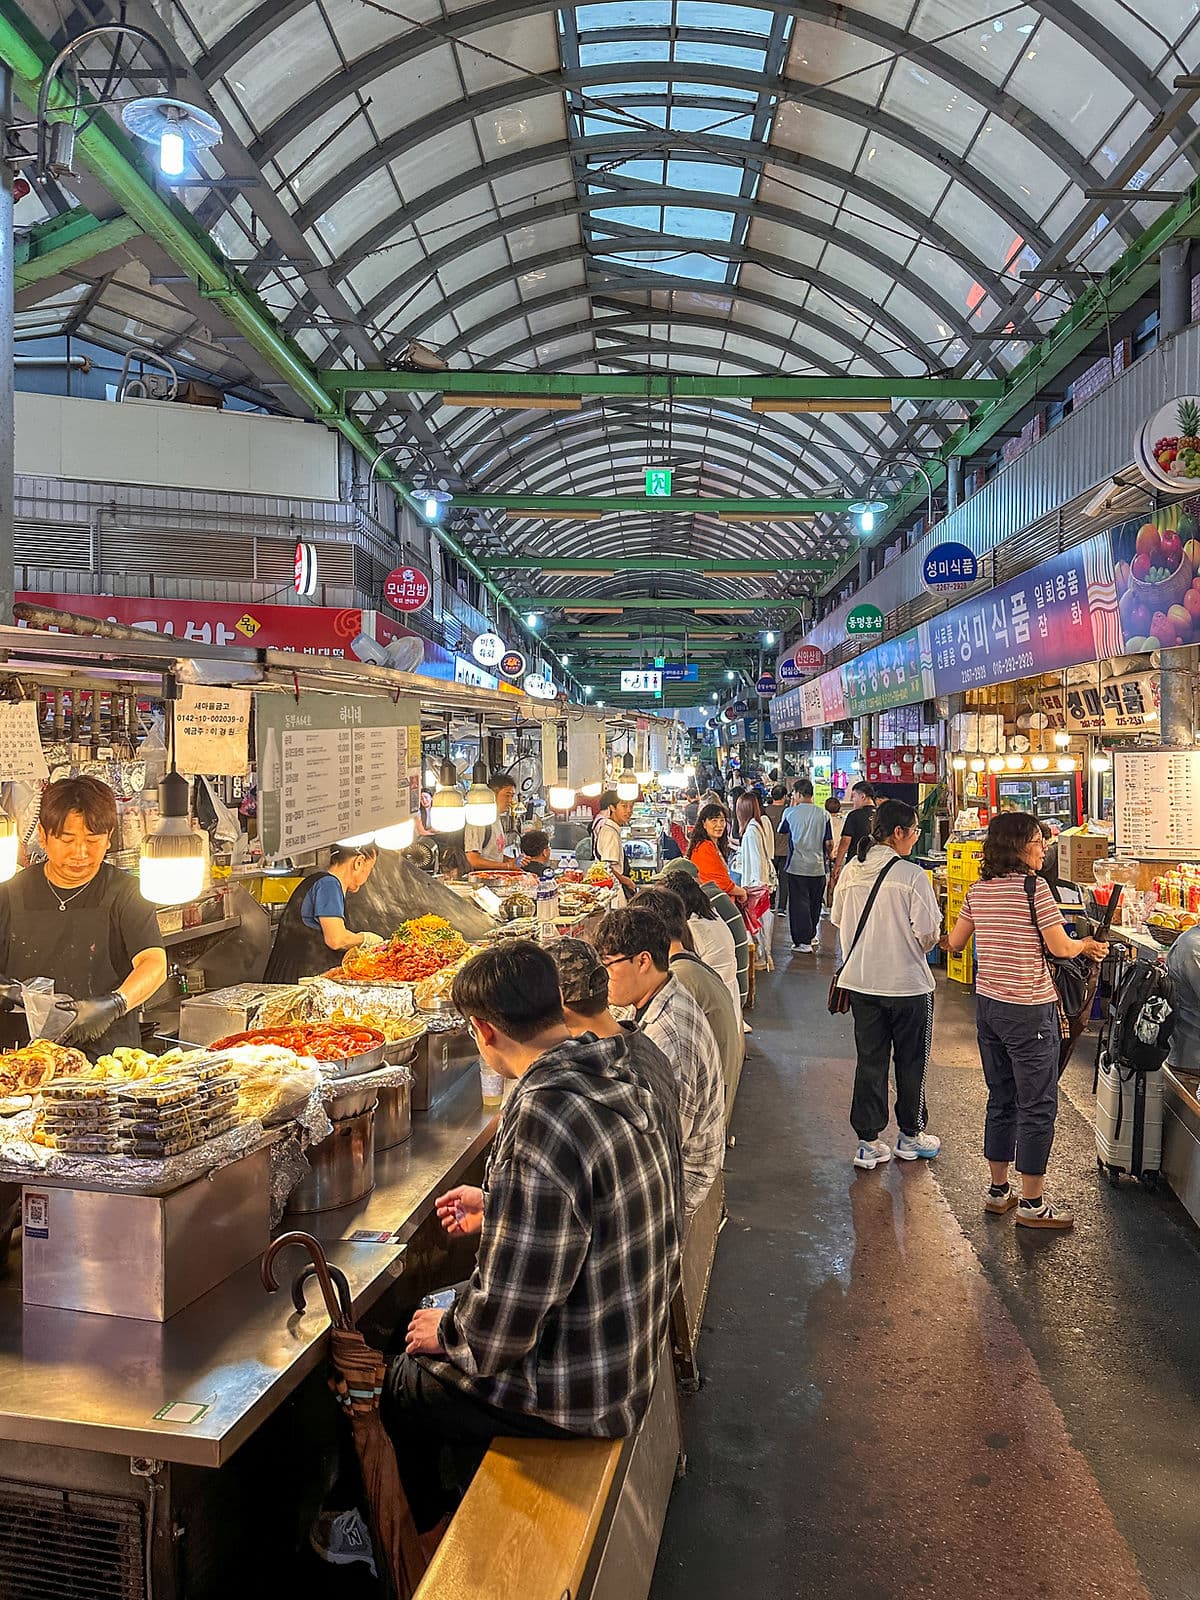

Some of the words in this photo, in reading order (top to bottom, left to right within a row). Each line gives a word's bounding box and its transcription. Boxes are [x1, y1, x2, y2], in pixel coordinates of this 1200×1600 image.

[926, 558, 974, 578] 성미식품
[387, 582, 427, 597] 모녀김밥
[1034, 569, 1079, 609] 일회용품
[240, 616, 257, 633] 모녀
[847, 615, 882, 629] 동명홍삼
[957, 590, 1031, 662] 성미식품
[1037, 613, 1048, 638] 잡
[1070, 600, 1083, 626] 화
[934, 624, 953, 647] 식료품
[937, 647, 956, 669] 선물용
[858, 642, 906, 696] 동명홍삼
[194, 702, 230, 710] 새마을금고
[1067, 681, 1146, 720] 성미식품
[176, 714, 244, 723] 0142-10-002039-0
[339, 705, 362, 724] 하니네
